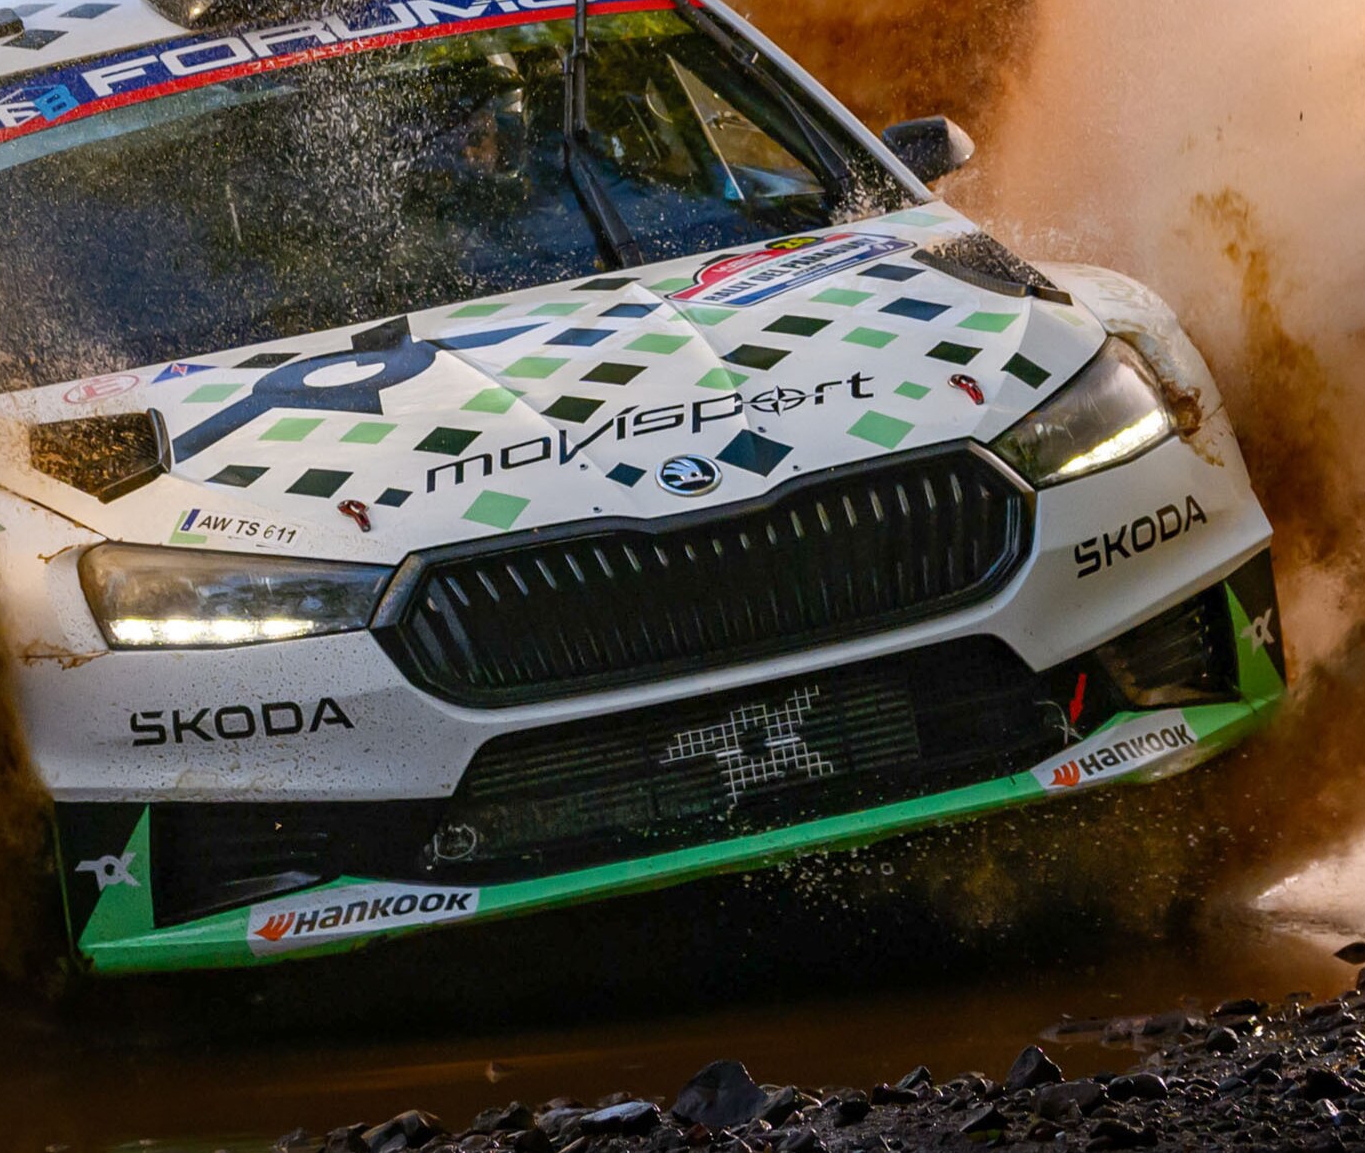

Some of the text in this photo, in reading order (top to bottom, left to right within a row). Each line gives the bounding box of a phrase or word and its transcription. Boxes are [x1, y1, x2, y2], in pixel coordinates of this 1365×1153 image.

[702, 281, 757, 302] RALLY
[748, 268, 792, 283] DEL
[198, 515, 233, 532] AW
[236, 520, 261, 537] TS
[263, 524, 297, 544] 611
